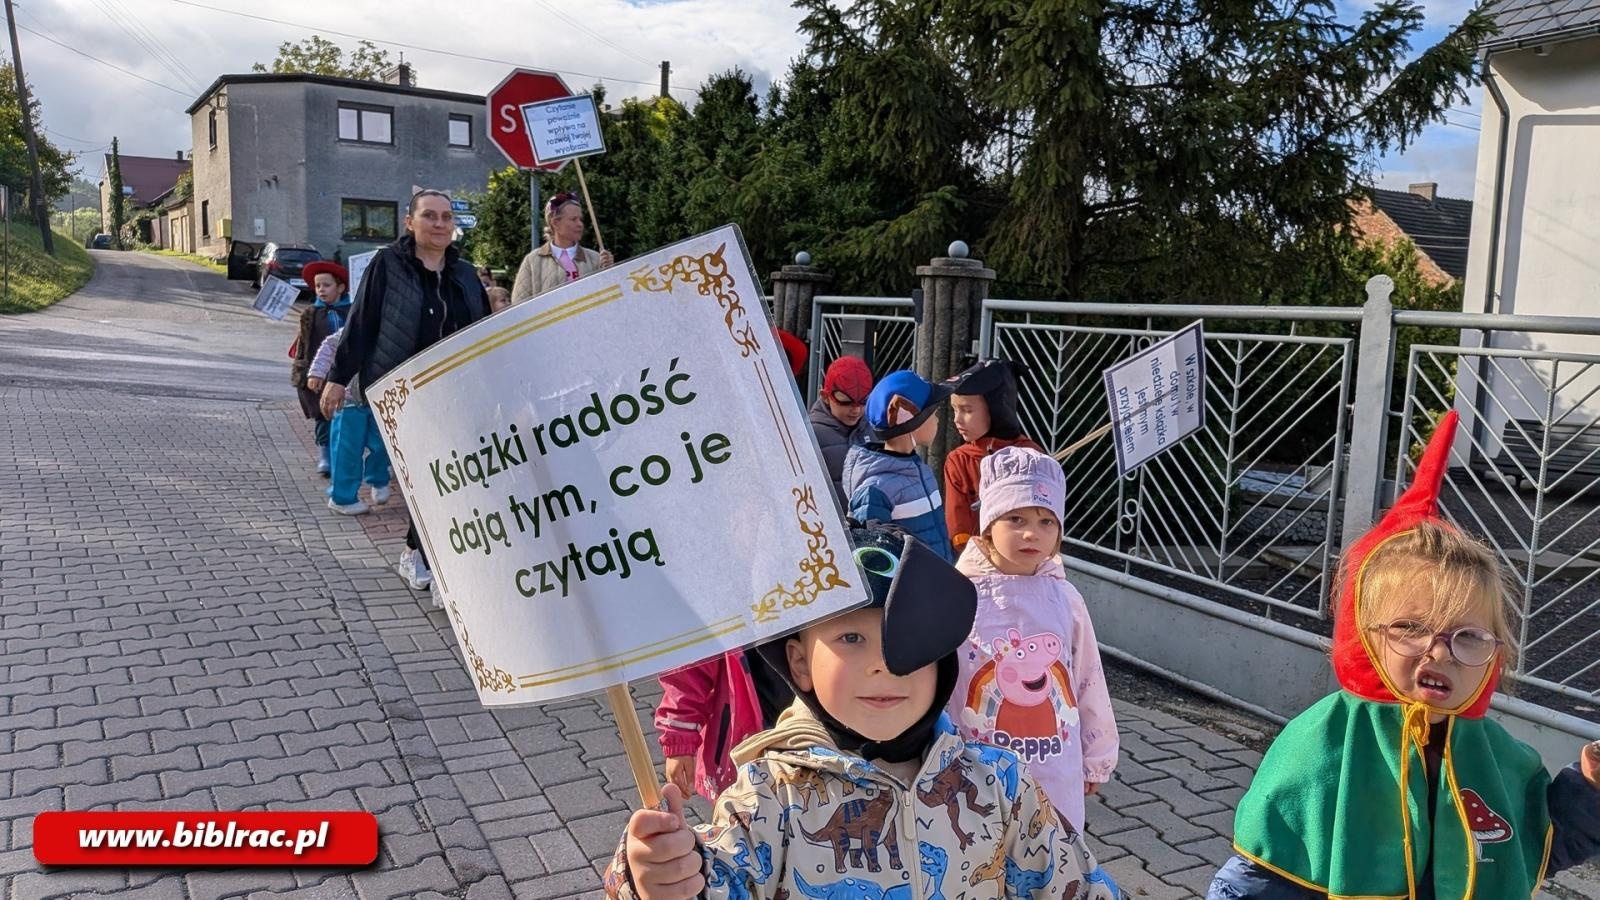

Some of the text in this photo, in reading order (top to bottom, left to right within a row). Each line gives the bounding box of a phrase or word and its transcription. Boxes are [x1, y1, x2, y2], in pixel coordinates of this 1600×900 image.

[545, 103, 576, 115] Czytanie
[578, 122, 586, 130] na
[546, 133, 571, 146] rozwój
[1185, 353, 1196, 366] W
[1170, 370, 1181, 401] domu
[1117, 386, 1135, 454] przyjacielem
[1171, 409, 1179, 417] w
[1186, 404, 1194, 414] w
[429, 357, 697, 497] Książki radość
[1137, 410, 1149, 435] mym
[449, 431, 732, 555] dają tym, co je
[515, 528, 666, 598] czytają
[993, 731, 1062, 762] Peppa
